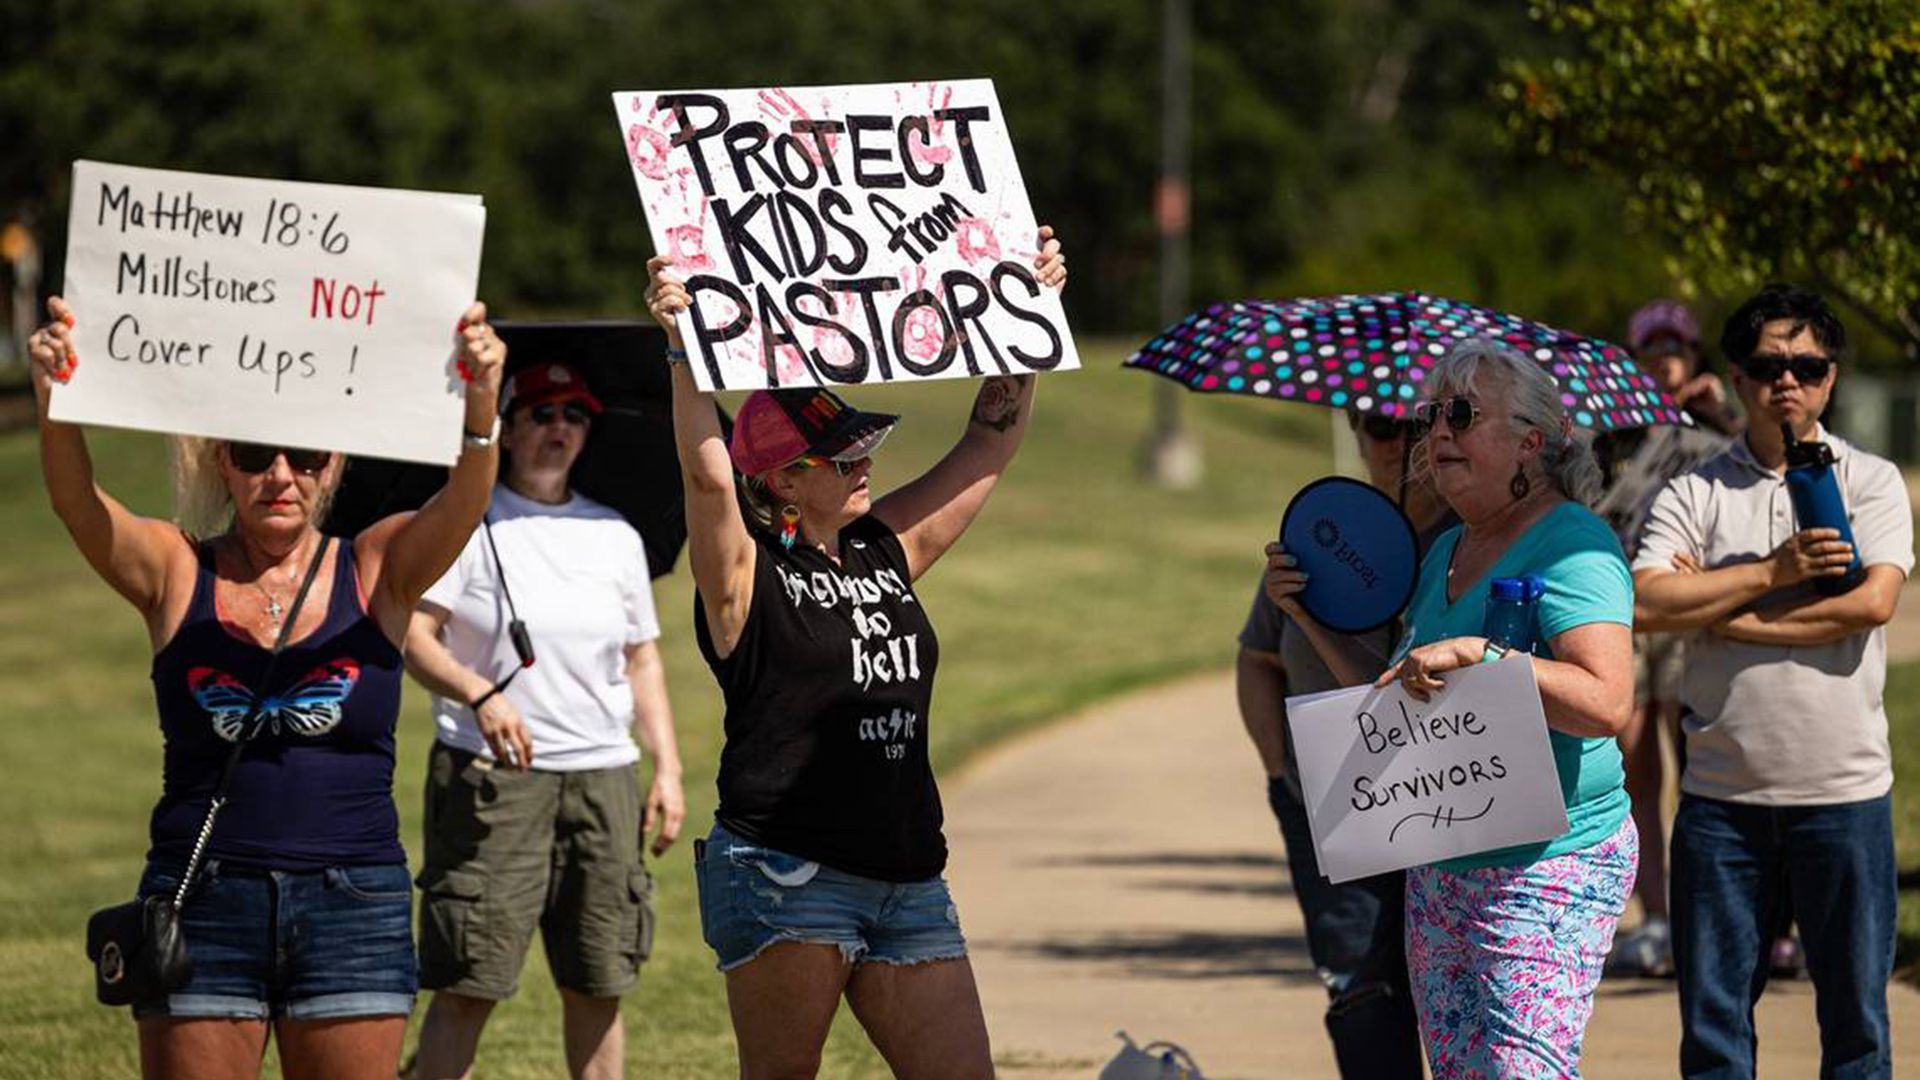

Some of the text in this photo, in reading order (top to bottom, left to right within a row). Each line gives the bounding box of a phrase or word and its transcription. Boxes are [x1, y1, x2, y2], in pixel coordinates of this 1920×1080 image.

[656, 93, 990, 196] PROTECT
[98, 181, 350, 255] Matthew 18:6
[710, 187, 974, 285] KIDS from
[117, 252, 276, 304] Millstones
[107, 313, 211, 364] Cover
[238, 335, 317, 394] Ups
[685, 260, 1063, 390] PASTORS
[851, 606, 892, 640] to
[851, 633, 921, 692] hell
[1356, 699, 1487, 755] Believe
